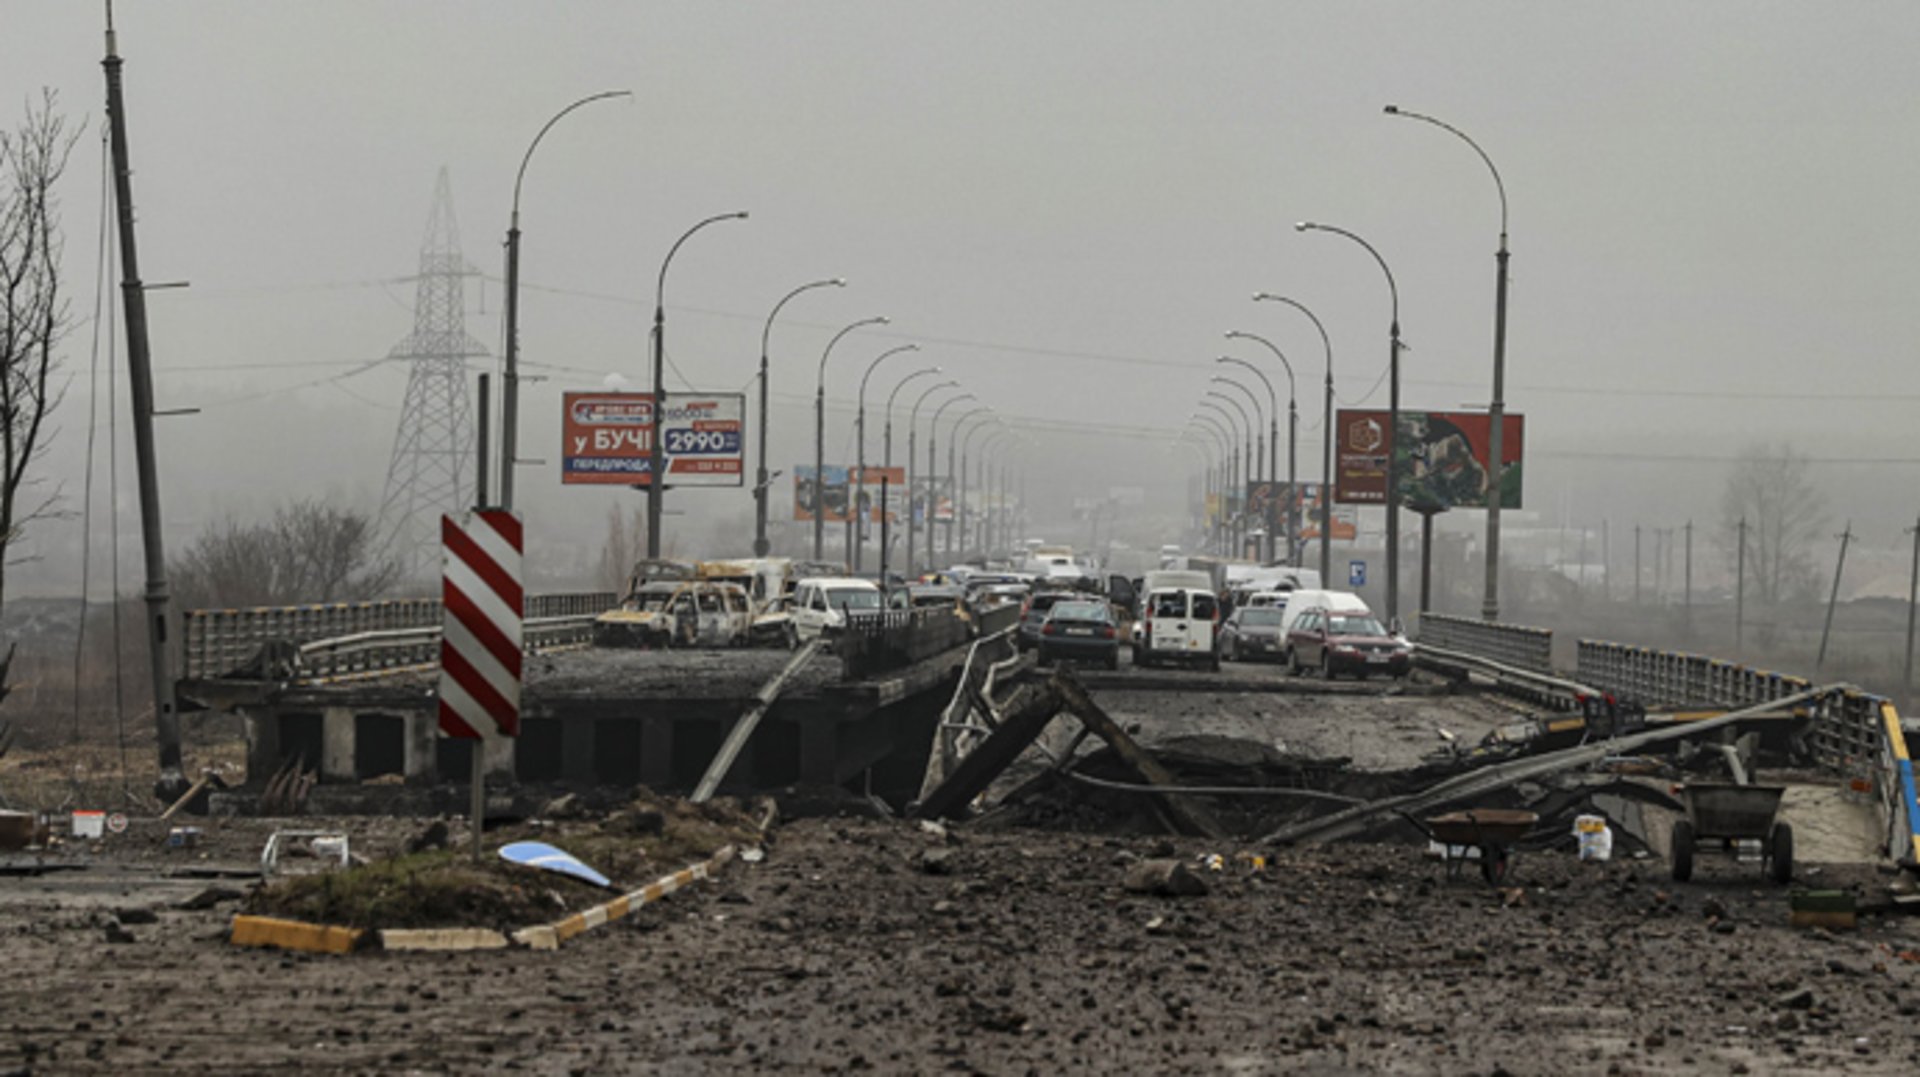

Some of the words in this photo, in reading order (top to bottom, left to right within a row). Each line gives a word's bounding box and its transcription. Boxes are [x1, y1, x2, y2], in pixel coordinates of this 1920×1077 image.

[594, 429, 652, 450] БУЧІ
[669, 432, 724, 451] 2990
[573, 459, 652, 472] ПЕРЕДПРОДА
